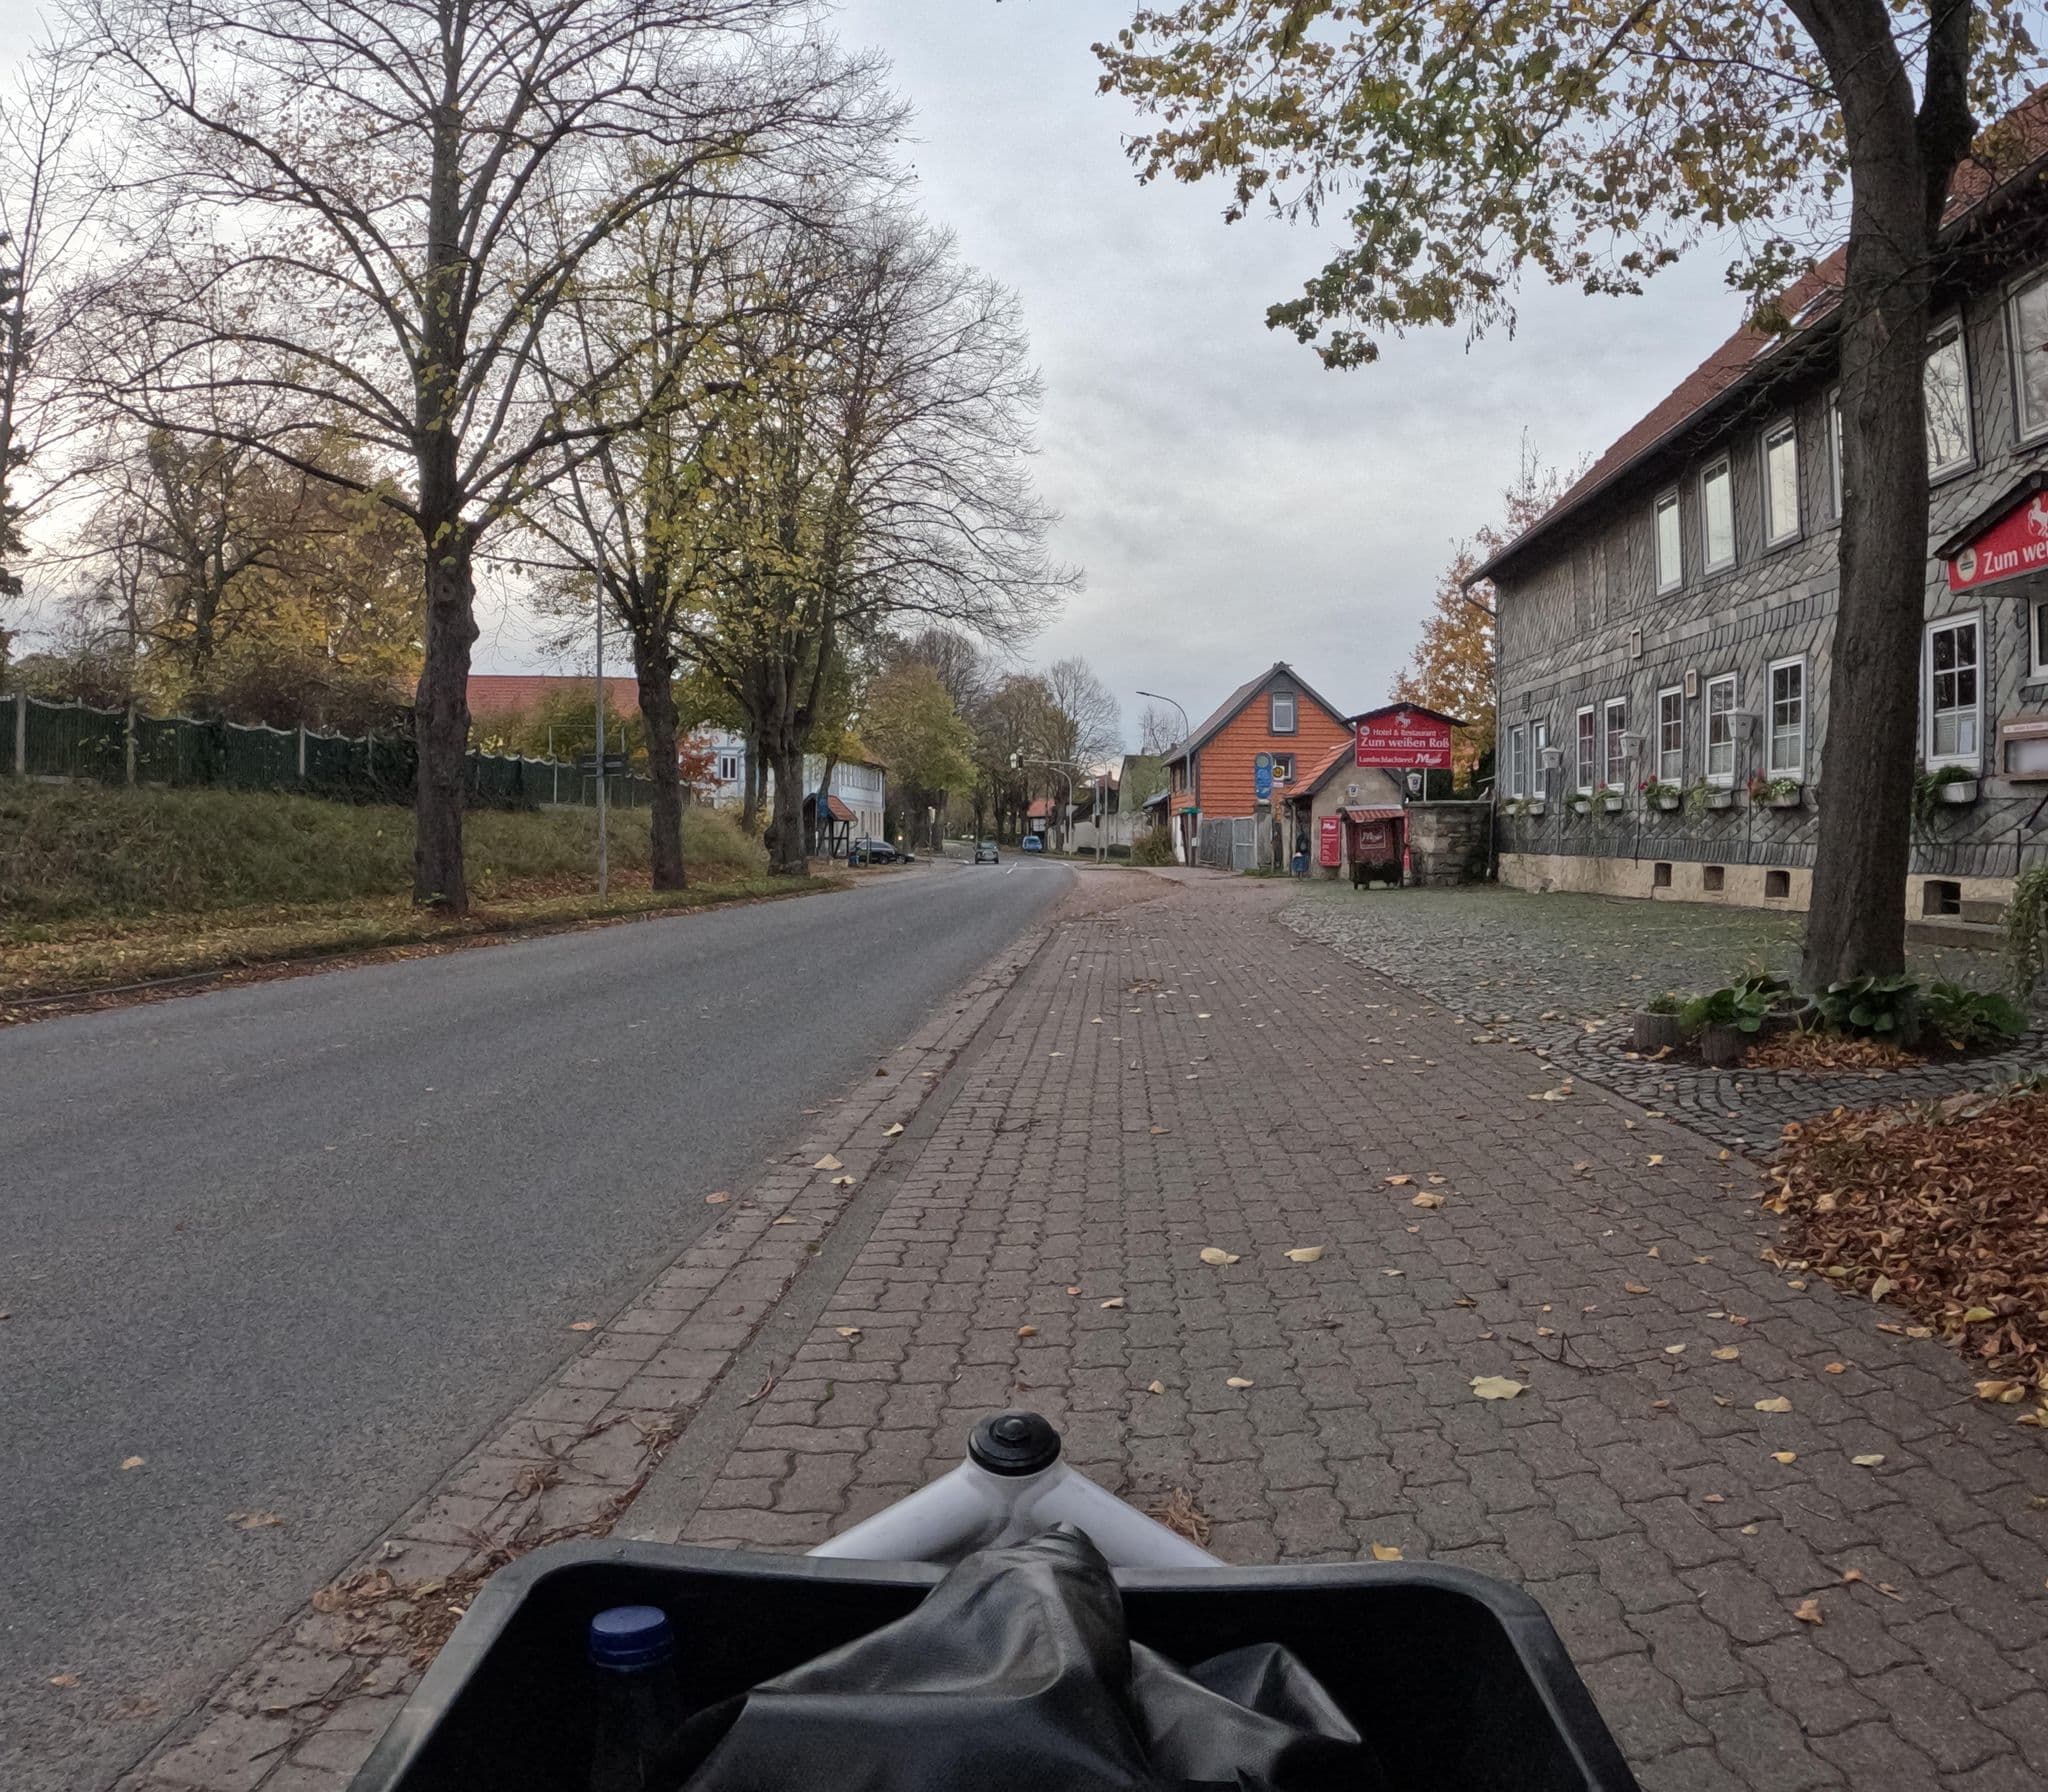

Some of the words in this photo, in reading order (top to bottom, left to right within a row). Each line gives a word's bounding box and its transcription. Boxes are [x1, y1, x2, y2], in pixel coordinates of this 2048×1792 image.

[1983, 550, 2018, 575] Zum
[1373, 728, 1392, 736] Hotel
[1400, 729, 1437, 737] Restaurant
[1361, 737, 1386, 747] Zum
[1388, 737, 1426, 748] weißen
[1429, 737, 1450, 748] Roß
